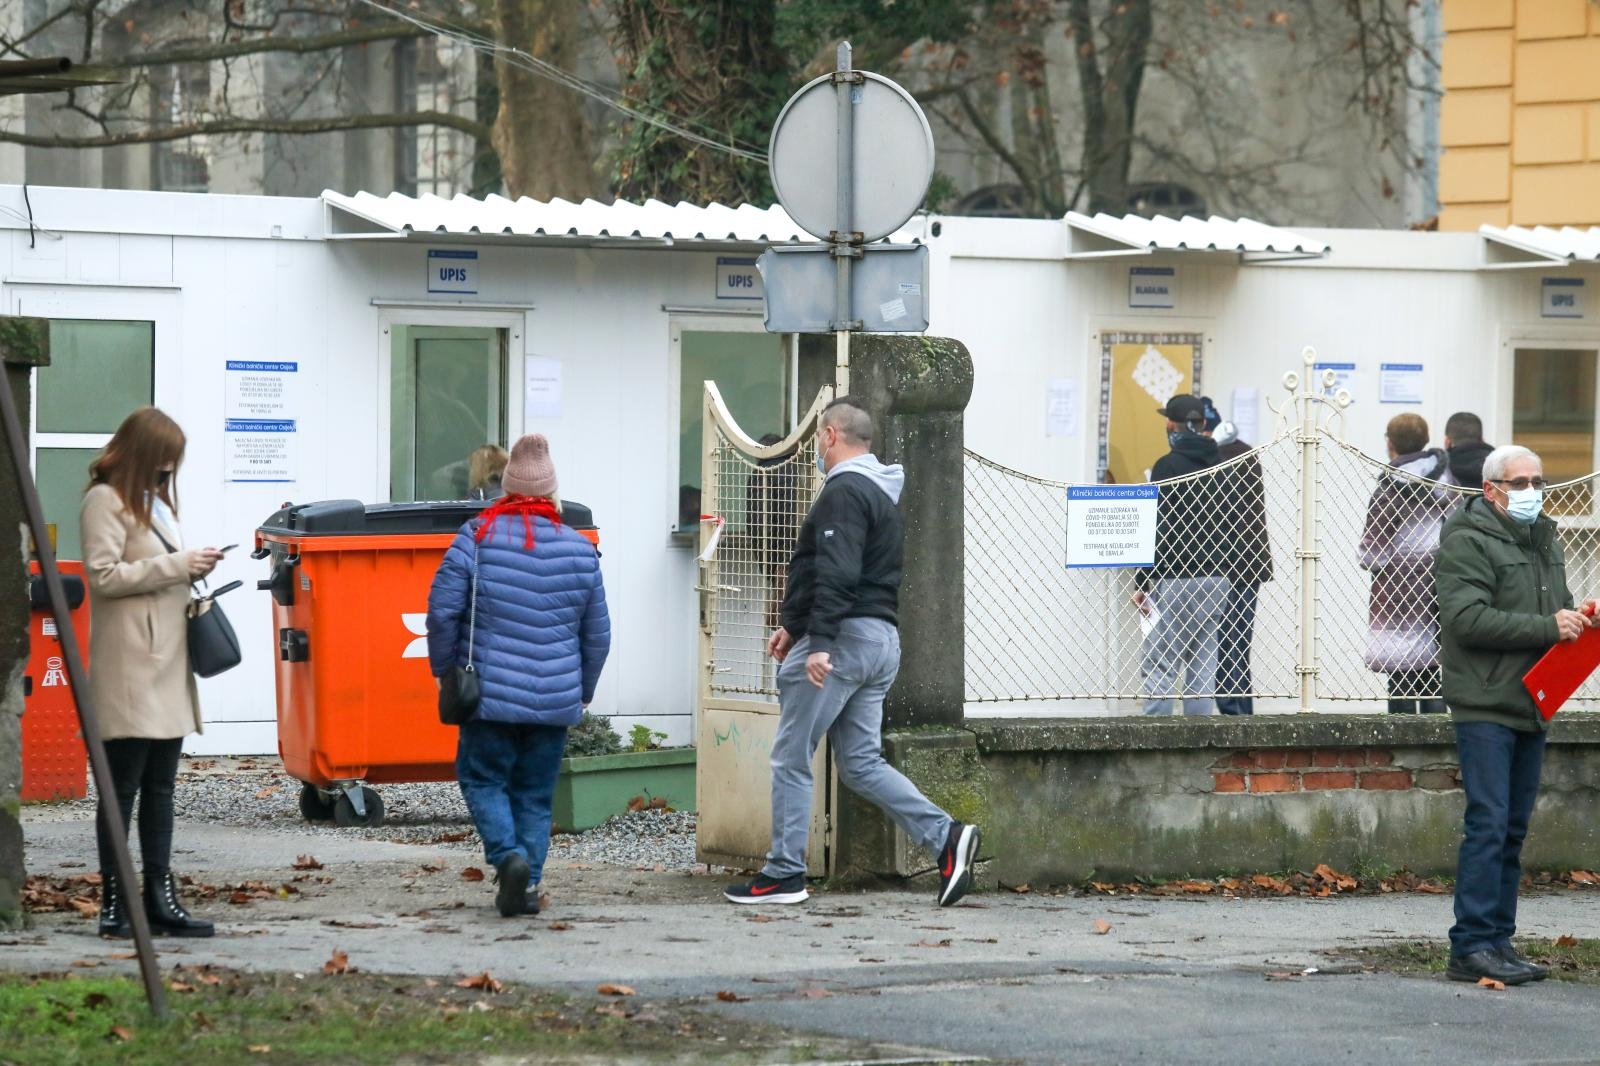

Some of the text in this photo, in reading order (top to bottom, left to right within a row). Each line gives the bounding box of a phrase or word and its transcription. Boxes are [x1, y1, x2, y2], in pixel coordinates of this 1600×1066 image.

[440, 267, 466, 282] UPIS
[728, 274, 753, 288] UPIS
[1551, 293, 1574, 307] UPIS
[1072, 489, 1093, 497] Klinički
[1094, 489, 1116, 497] bolnički
